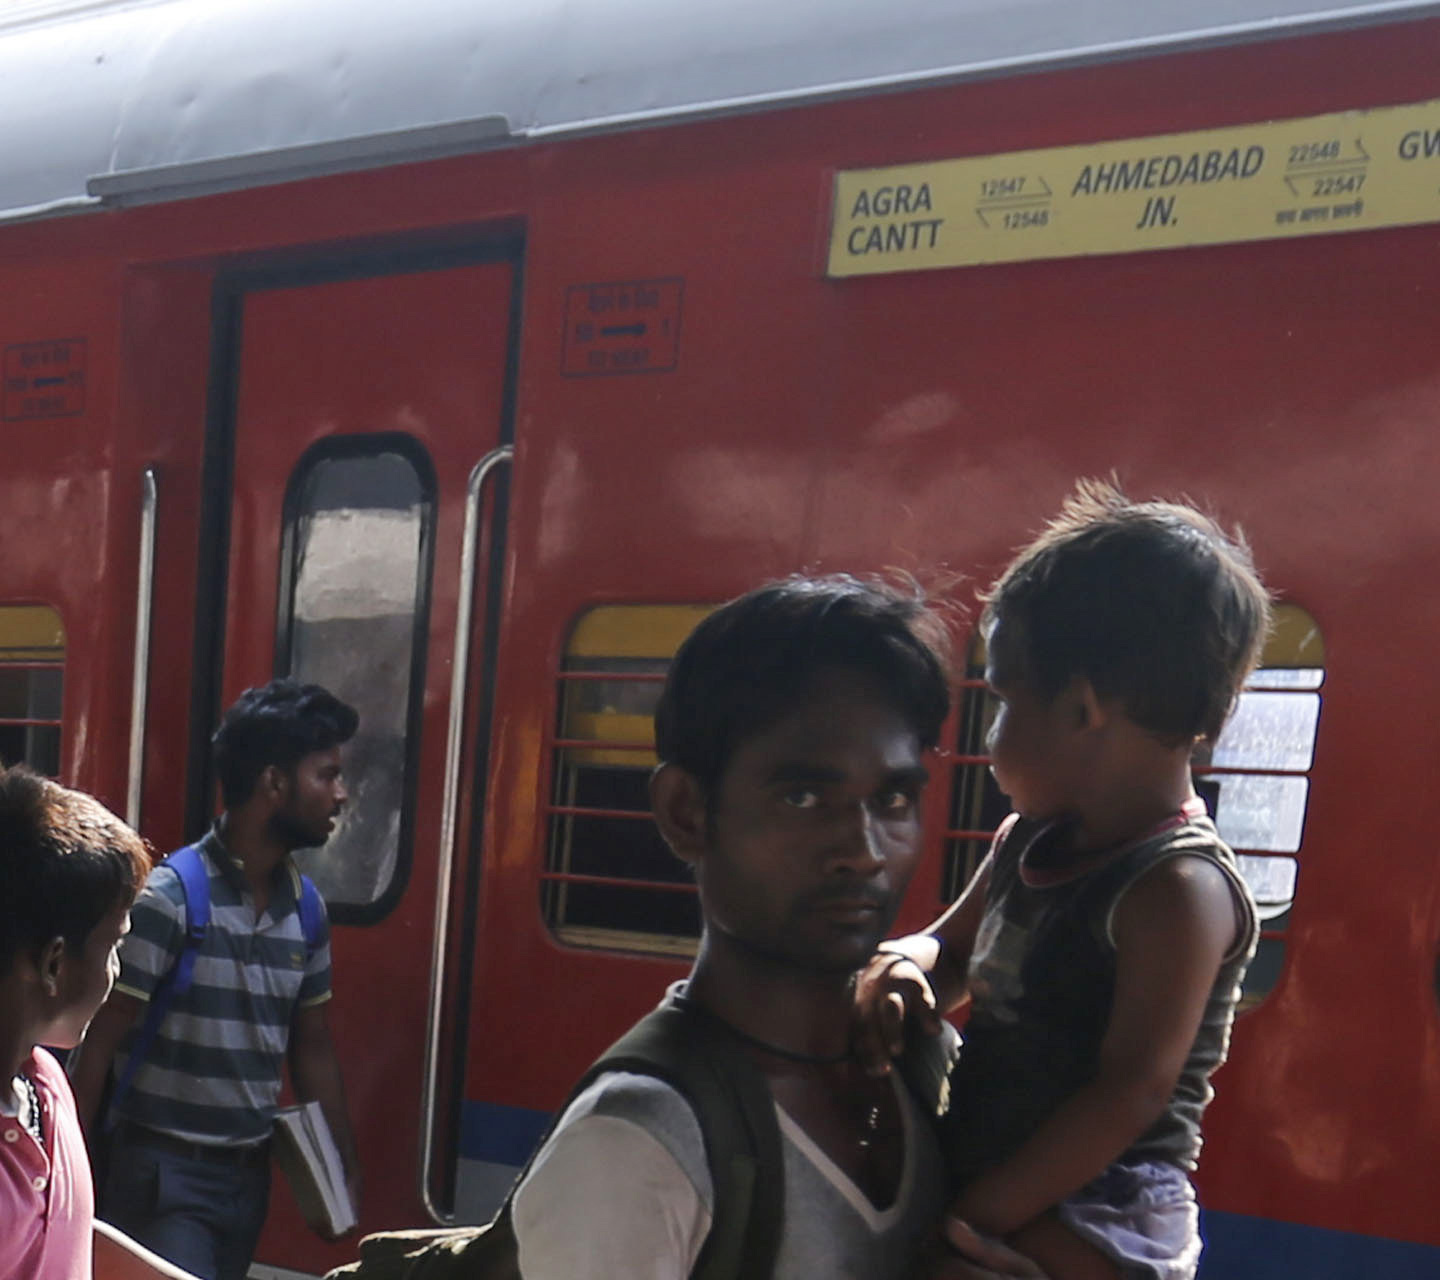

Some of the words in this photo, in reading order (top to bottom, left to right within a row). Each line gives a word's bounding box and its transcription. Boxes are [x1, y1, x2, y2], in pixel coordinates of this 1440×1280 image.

[1071, 144, 1264, 198] AHMEDABAD
[851, 182, 932, 219] AGRA
[1136, 196, 1179, 229] JN.
[847, 217, 944, 255] CANTT
